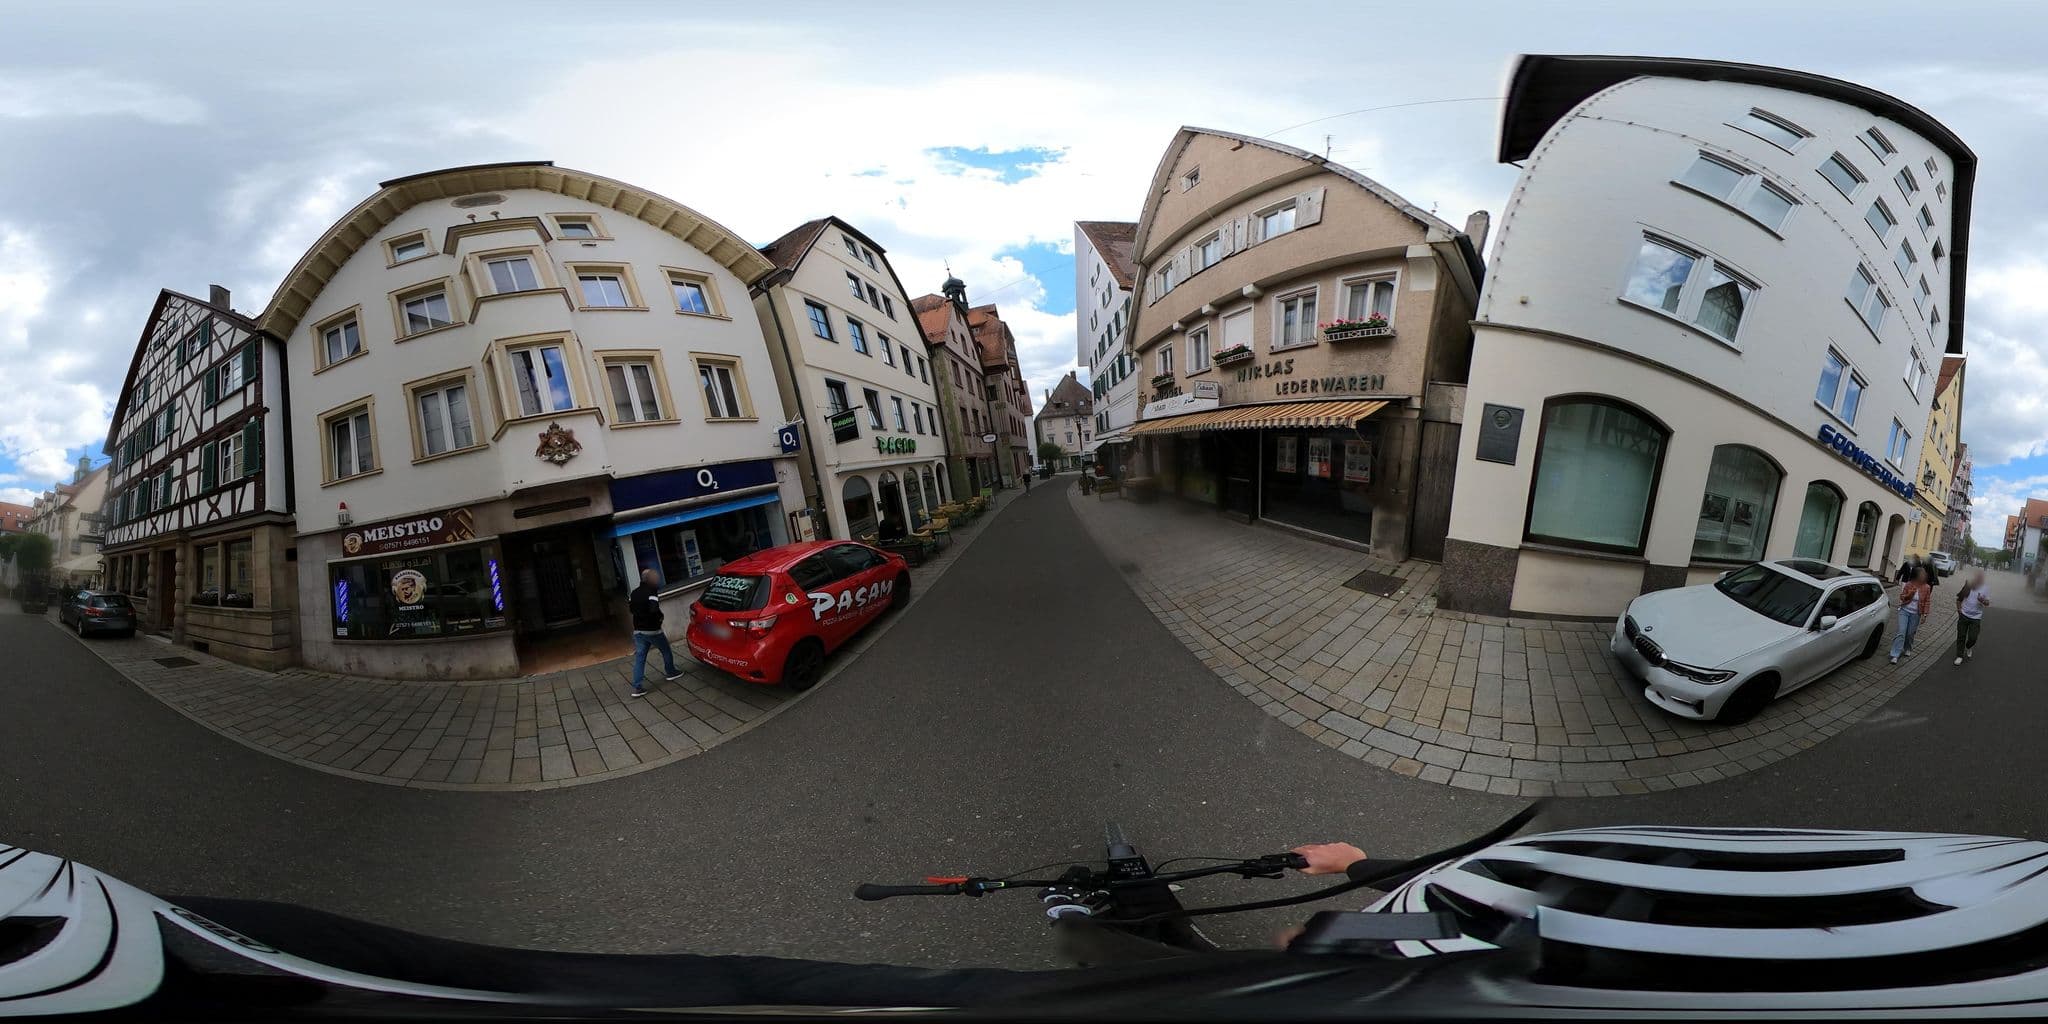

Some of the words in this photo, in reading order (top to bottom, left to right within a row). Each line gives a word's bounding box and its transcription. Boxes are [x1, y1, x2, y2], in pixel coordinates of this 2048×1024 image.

[1237, 358, 1295, 383] NIKLAS
[1275, 374, 1385, 396] LEDERWAREN
[364, 517, 443, 542] MEISTRO
[807, 579, 893, 621] PASAM
